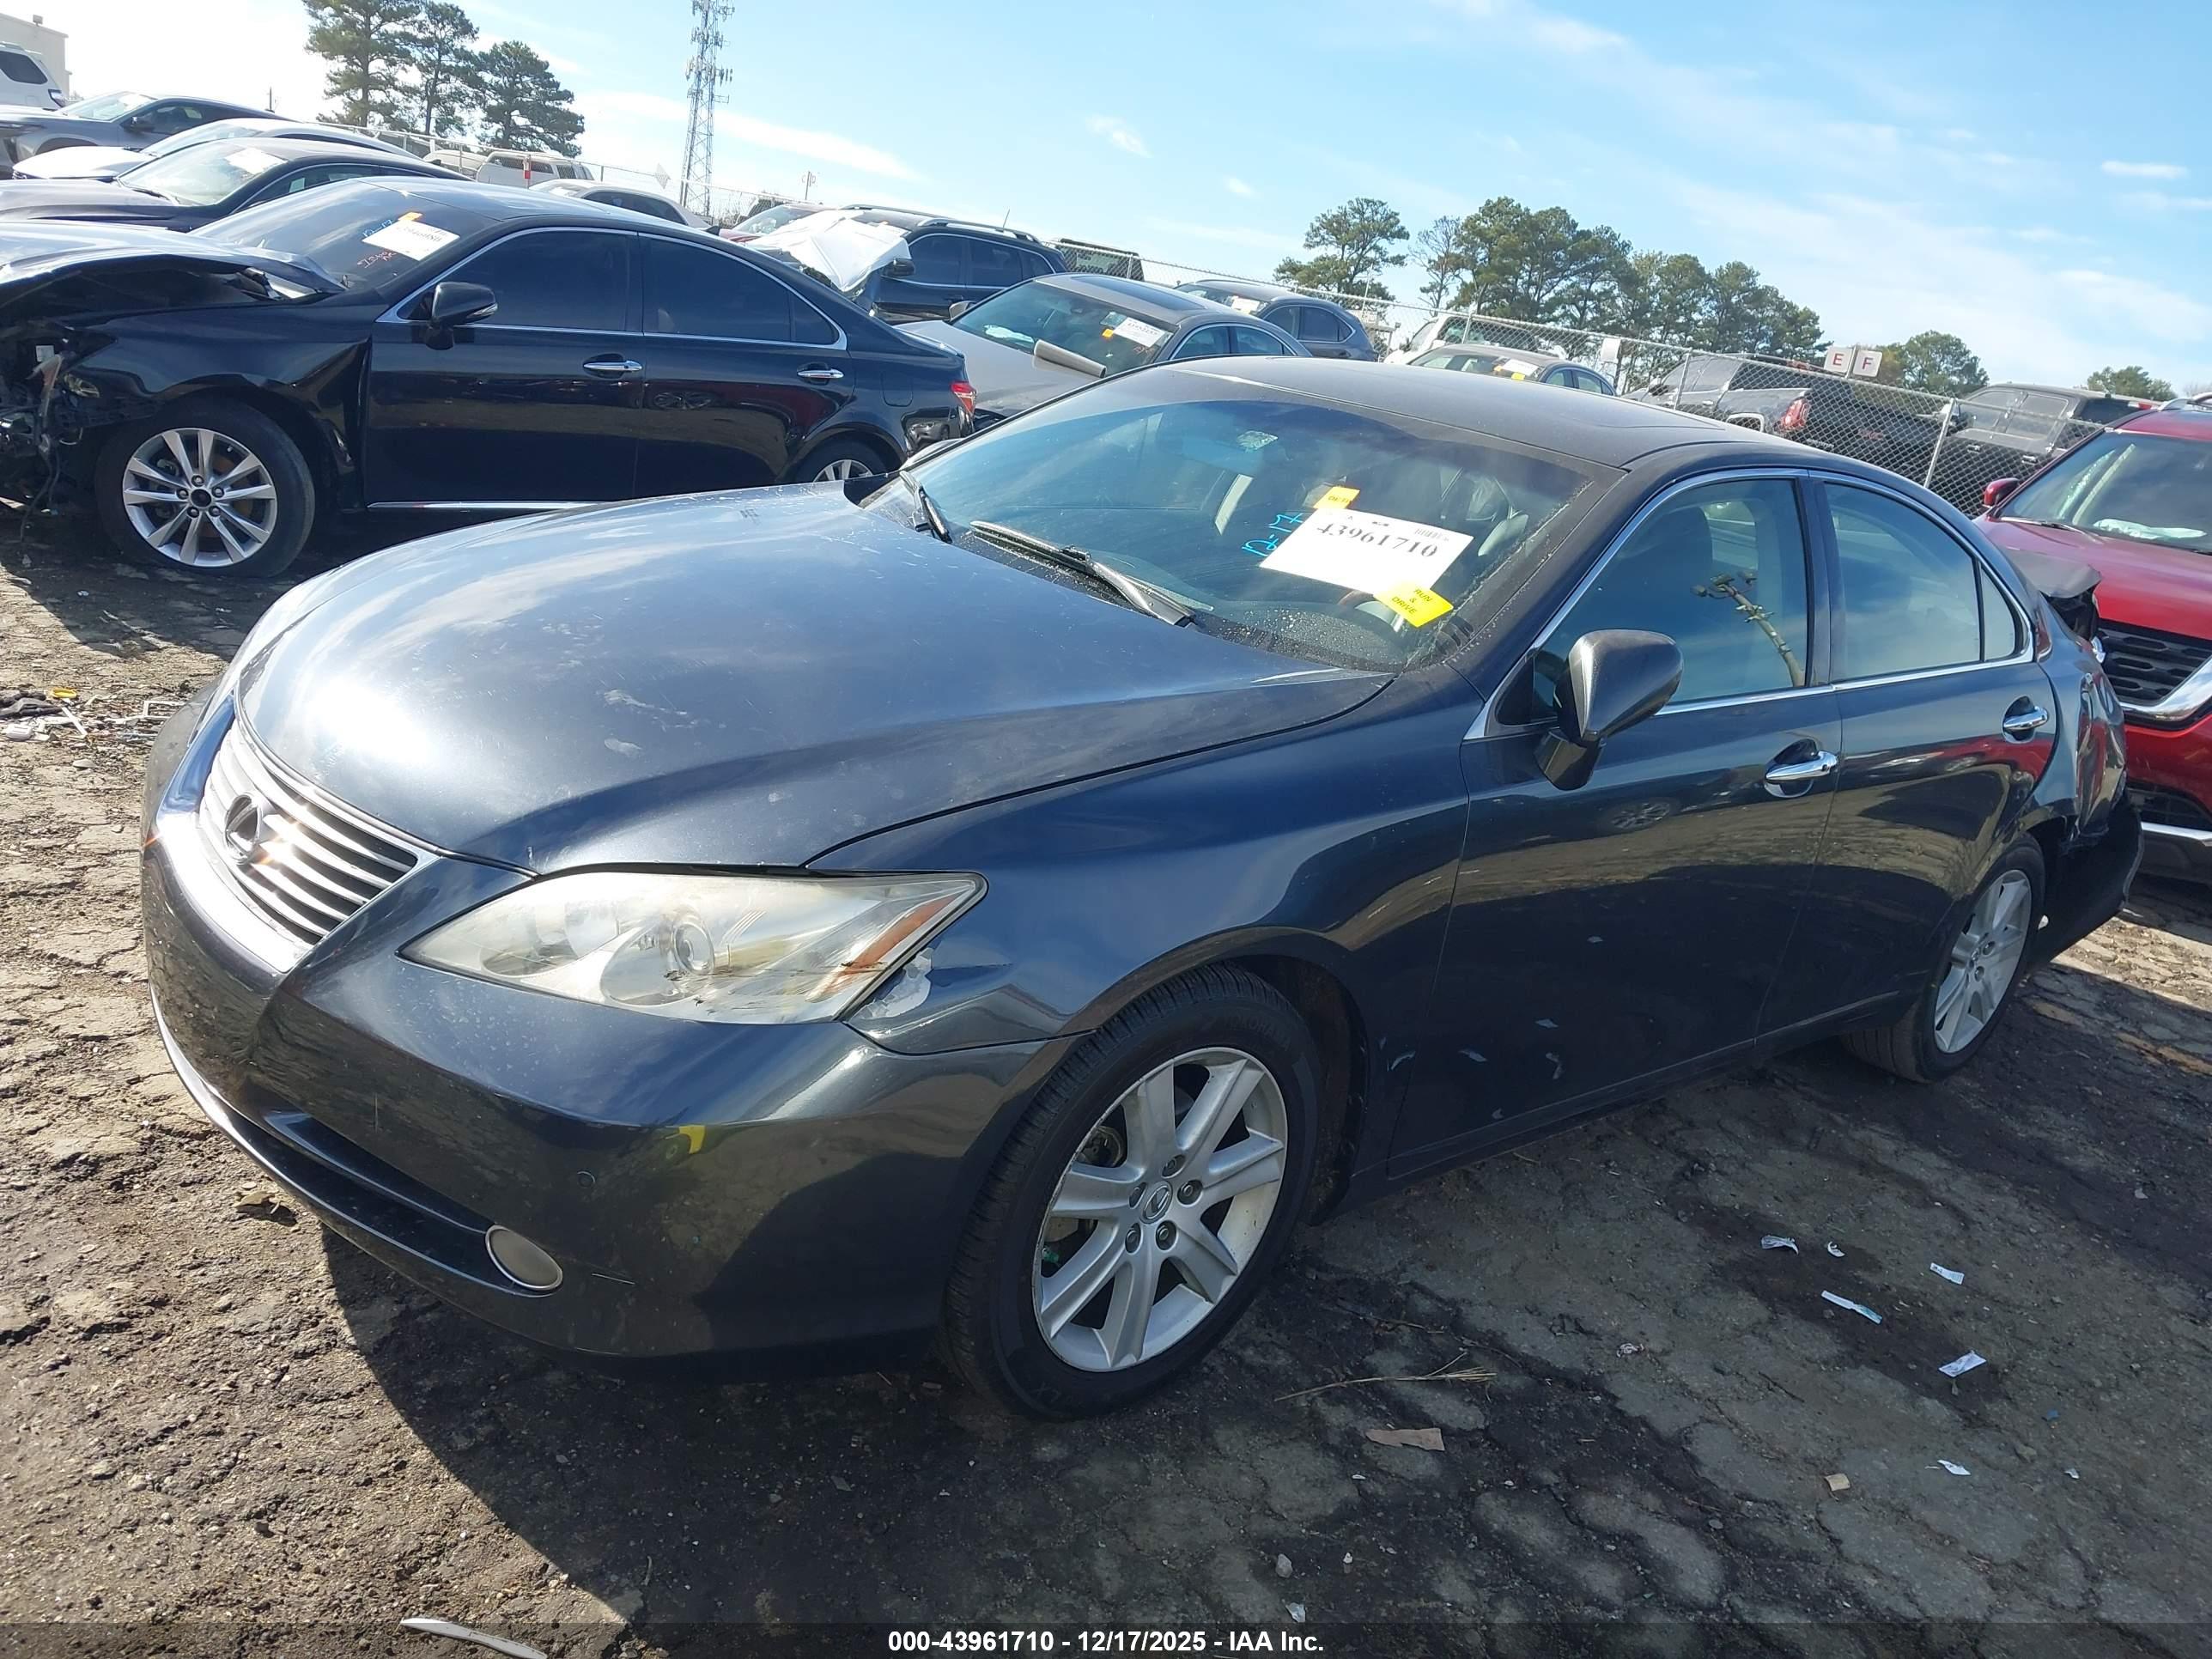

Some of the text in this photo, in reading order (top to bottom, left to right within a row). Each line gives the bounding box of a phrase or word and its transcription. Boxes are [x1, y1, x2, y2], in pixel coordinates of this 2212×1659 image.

[1832, 352, 1845, 367] E
[1861, 356, 1874, 370] F
[1316, 522, 1438, 557] 43961710
[1413, 587, 1434, 603] RUN
[1391, 595, 1419, 615] DRIVE
